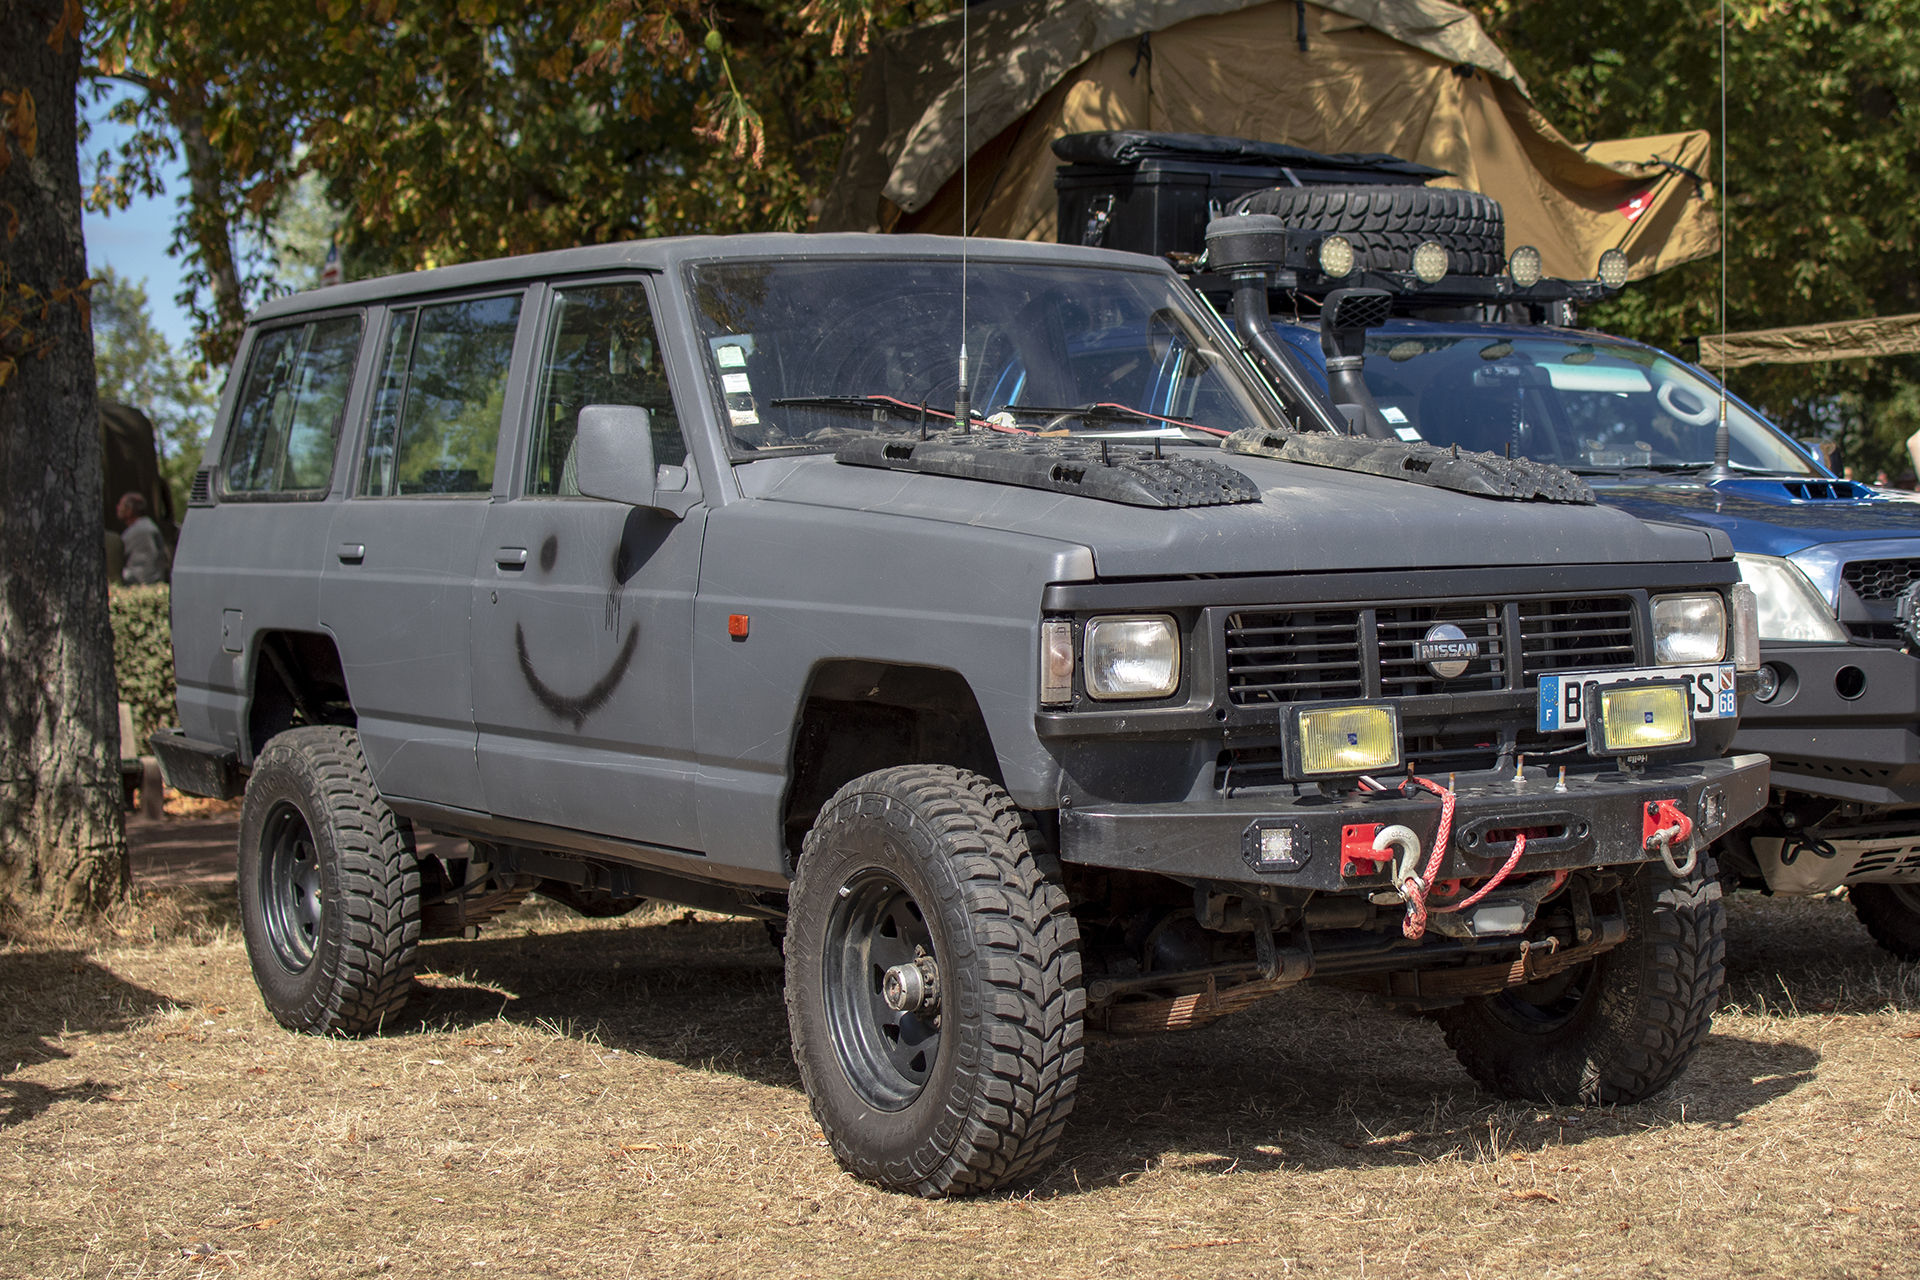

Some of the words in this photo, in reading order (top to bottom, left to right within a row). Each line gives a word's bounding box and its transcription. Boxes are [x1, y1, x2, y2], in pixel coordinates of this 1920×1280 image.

[1421, 643, 1478, 659] NISSAN
[1720, 692, 1734, 713] 68
[1546, 709, 1553, 721] F
[1627, 754, 1648, 764] Hella
